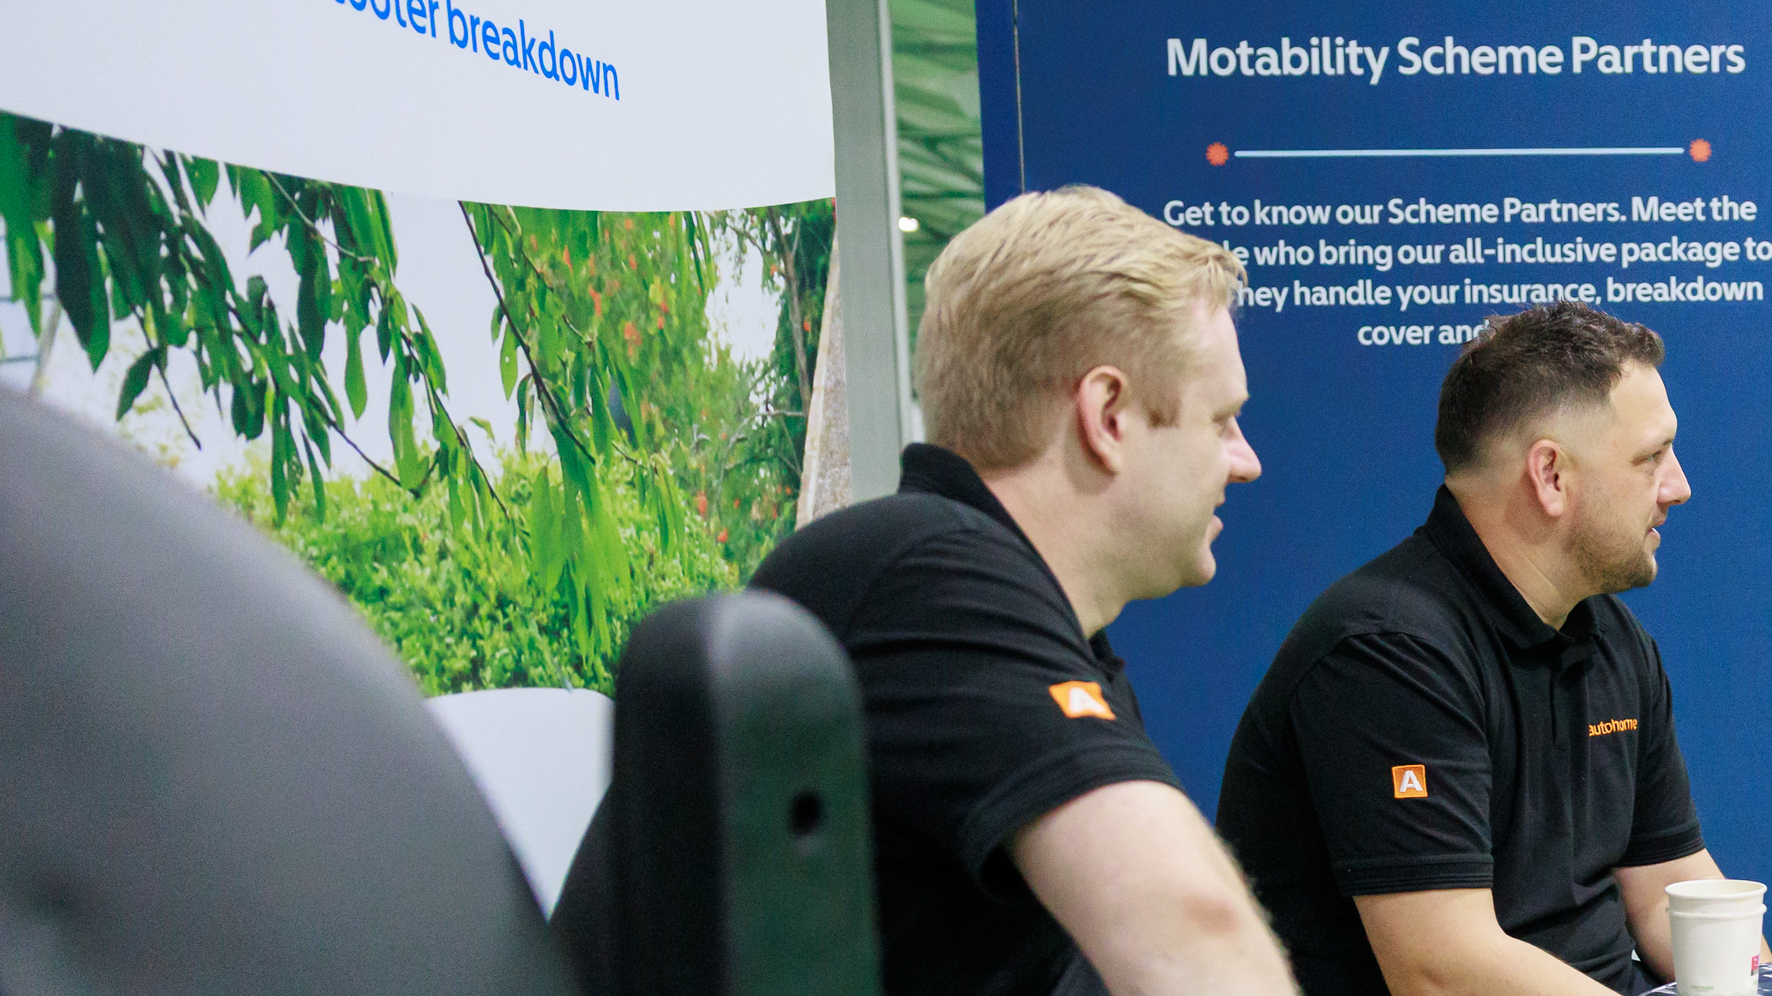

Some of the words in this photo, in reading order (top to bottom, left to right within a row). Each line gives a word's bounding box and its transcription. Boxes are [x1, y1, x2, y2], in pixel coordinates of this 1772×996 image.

[446, 0, 620, 101] breakdown
[1166, 37, 1390, 84] Motability
[1398, 36, 1564, 76] Scheme
[1571, 35, 1746, 75] Partners
[1163, 199, 1216, 227] Get
[1218, 202, 1250, 227] to
[1254, 198, 1331, 226] know
[1335, 203, 1384, 225] our
[1387, 197, 1499, 225] Scheme
[1503, 196, 1627, 223] Partners.
[1631, 195, 1706, 222] Meet
[1709, 194, 1758, 221] the
[1253, 239, 1315, 266] who
[1318, 238, 1394, 272] bring
[1397, 243, 1446, 265] our
[1448, 236, 1617, 264] all-inclusive
[1621, 235, 1741, 269] package
[1236, 279, 1290, 313] hey
[1293, 279, 1393, 307] handle
[1395, 282, 1460, 312] your
[1463, 277, 1602, 305] insurance,
[1606, 275, 1764, 303] breakdown
[1356, 325, 1435, 347] cover
[1588, 718, 1638, 737] autohome
[1399, 770, 1423, 793] A
